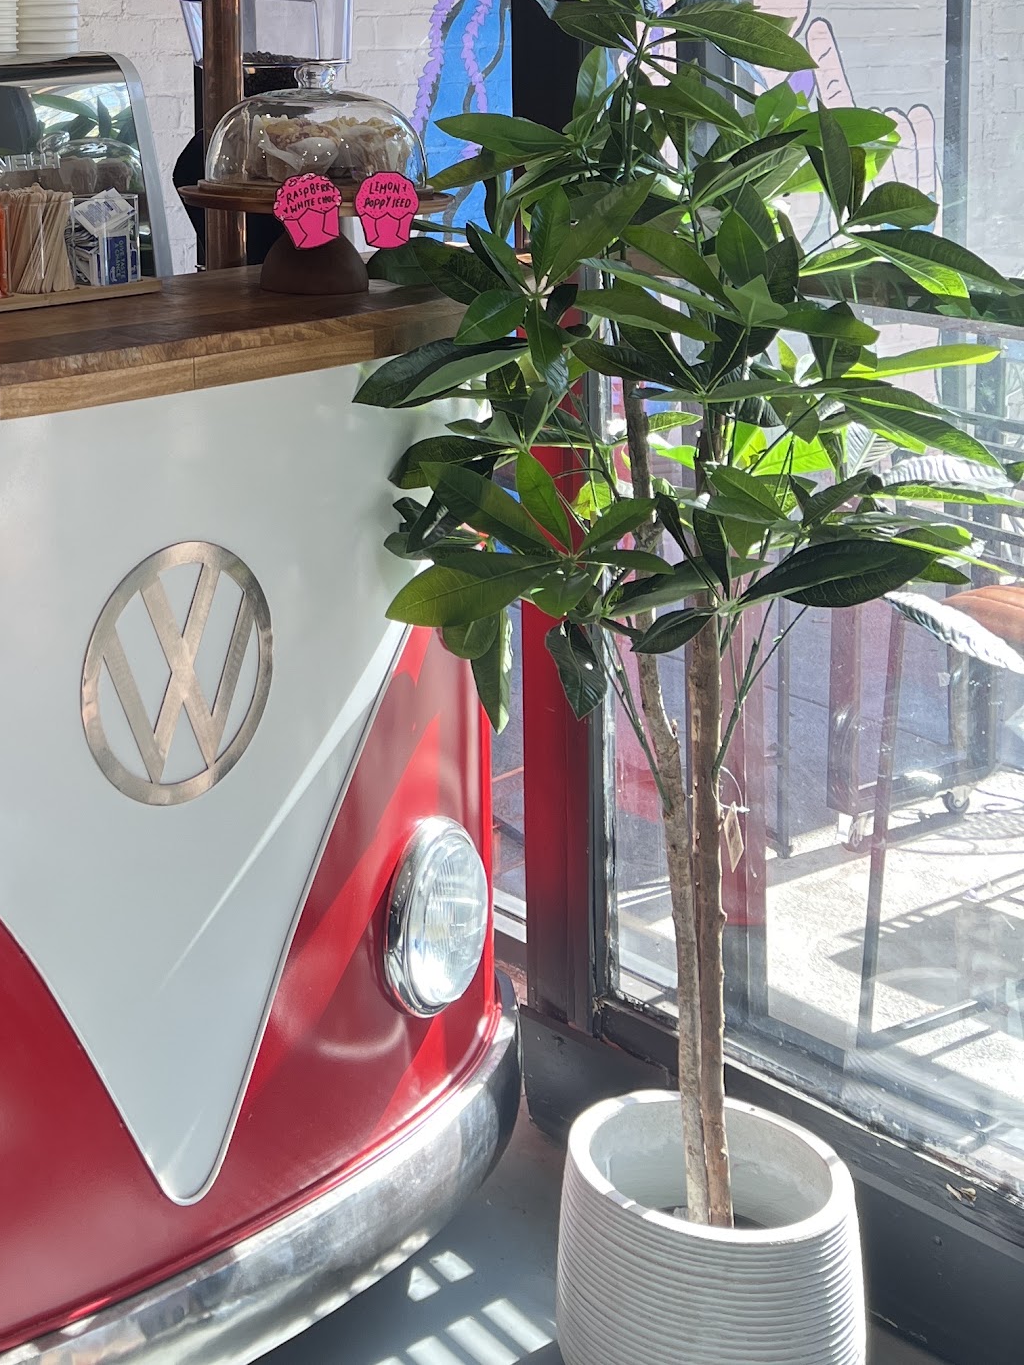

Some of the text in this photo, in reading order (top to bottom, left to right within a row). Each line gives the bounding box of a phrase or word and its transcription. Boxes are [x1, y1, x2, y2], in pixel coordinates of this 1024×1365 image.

[286, 182, 336, 205] RASPBERRY
[369, 181, 400, 195] LEMON
[289, 198, 315, 213] WHITE
[317, 195, 336, 205] CHOC
[363, 195, 412, 210] POPPY SEED
